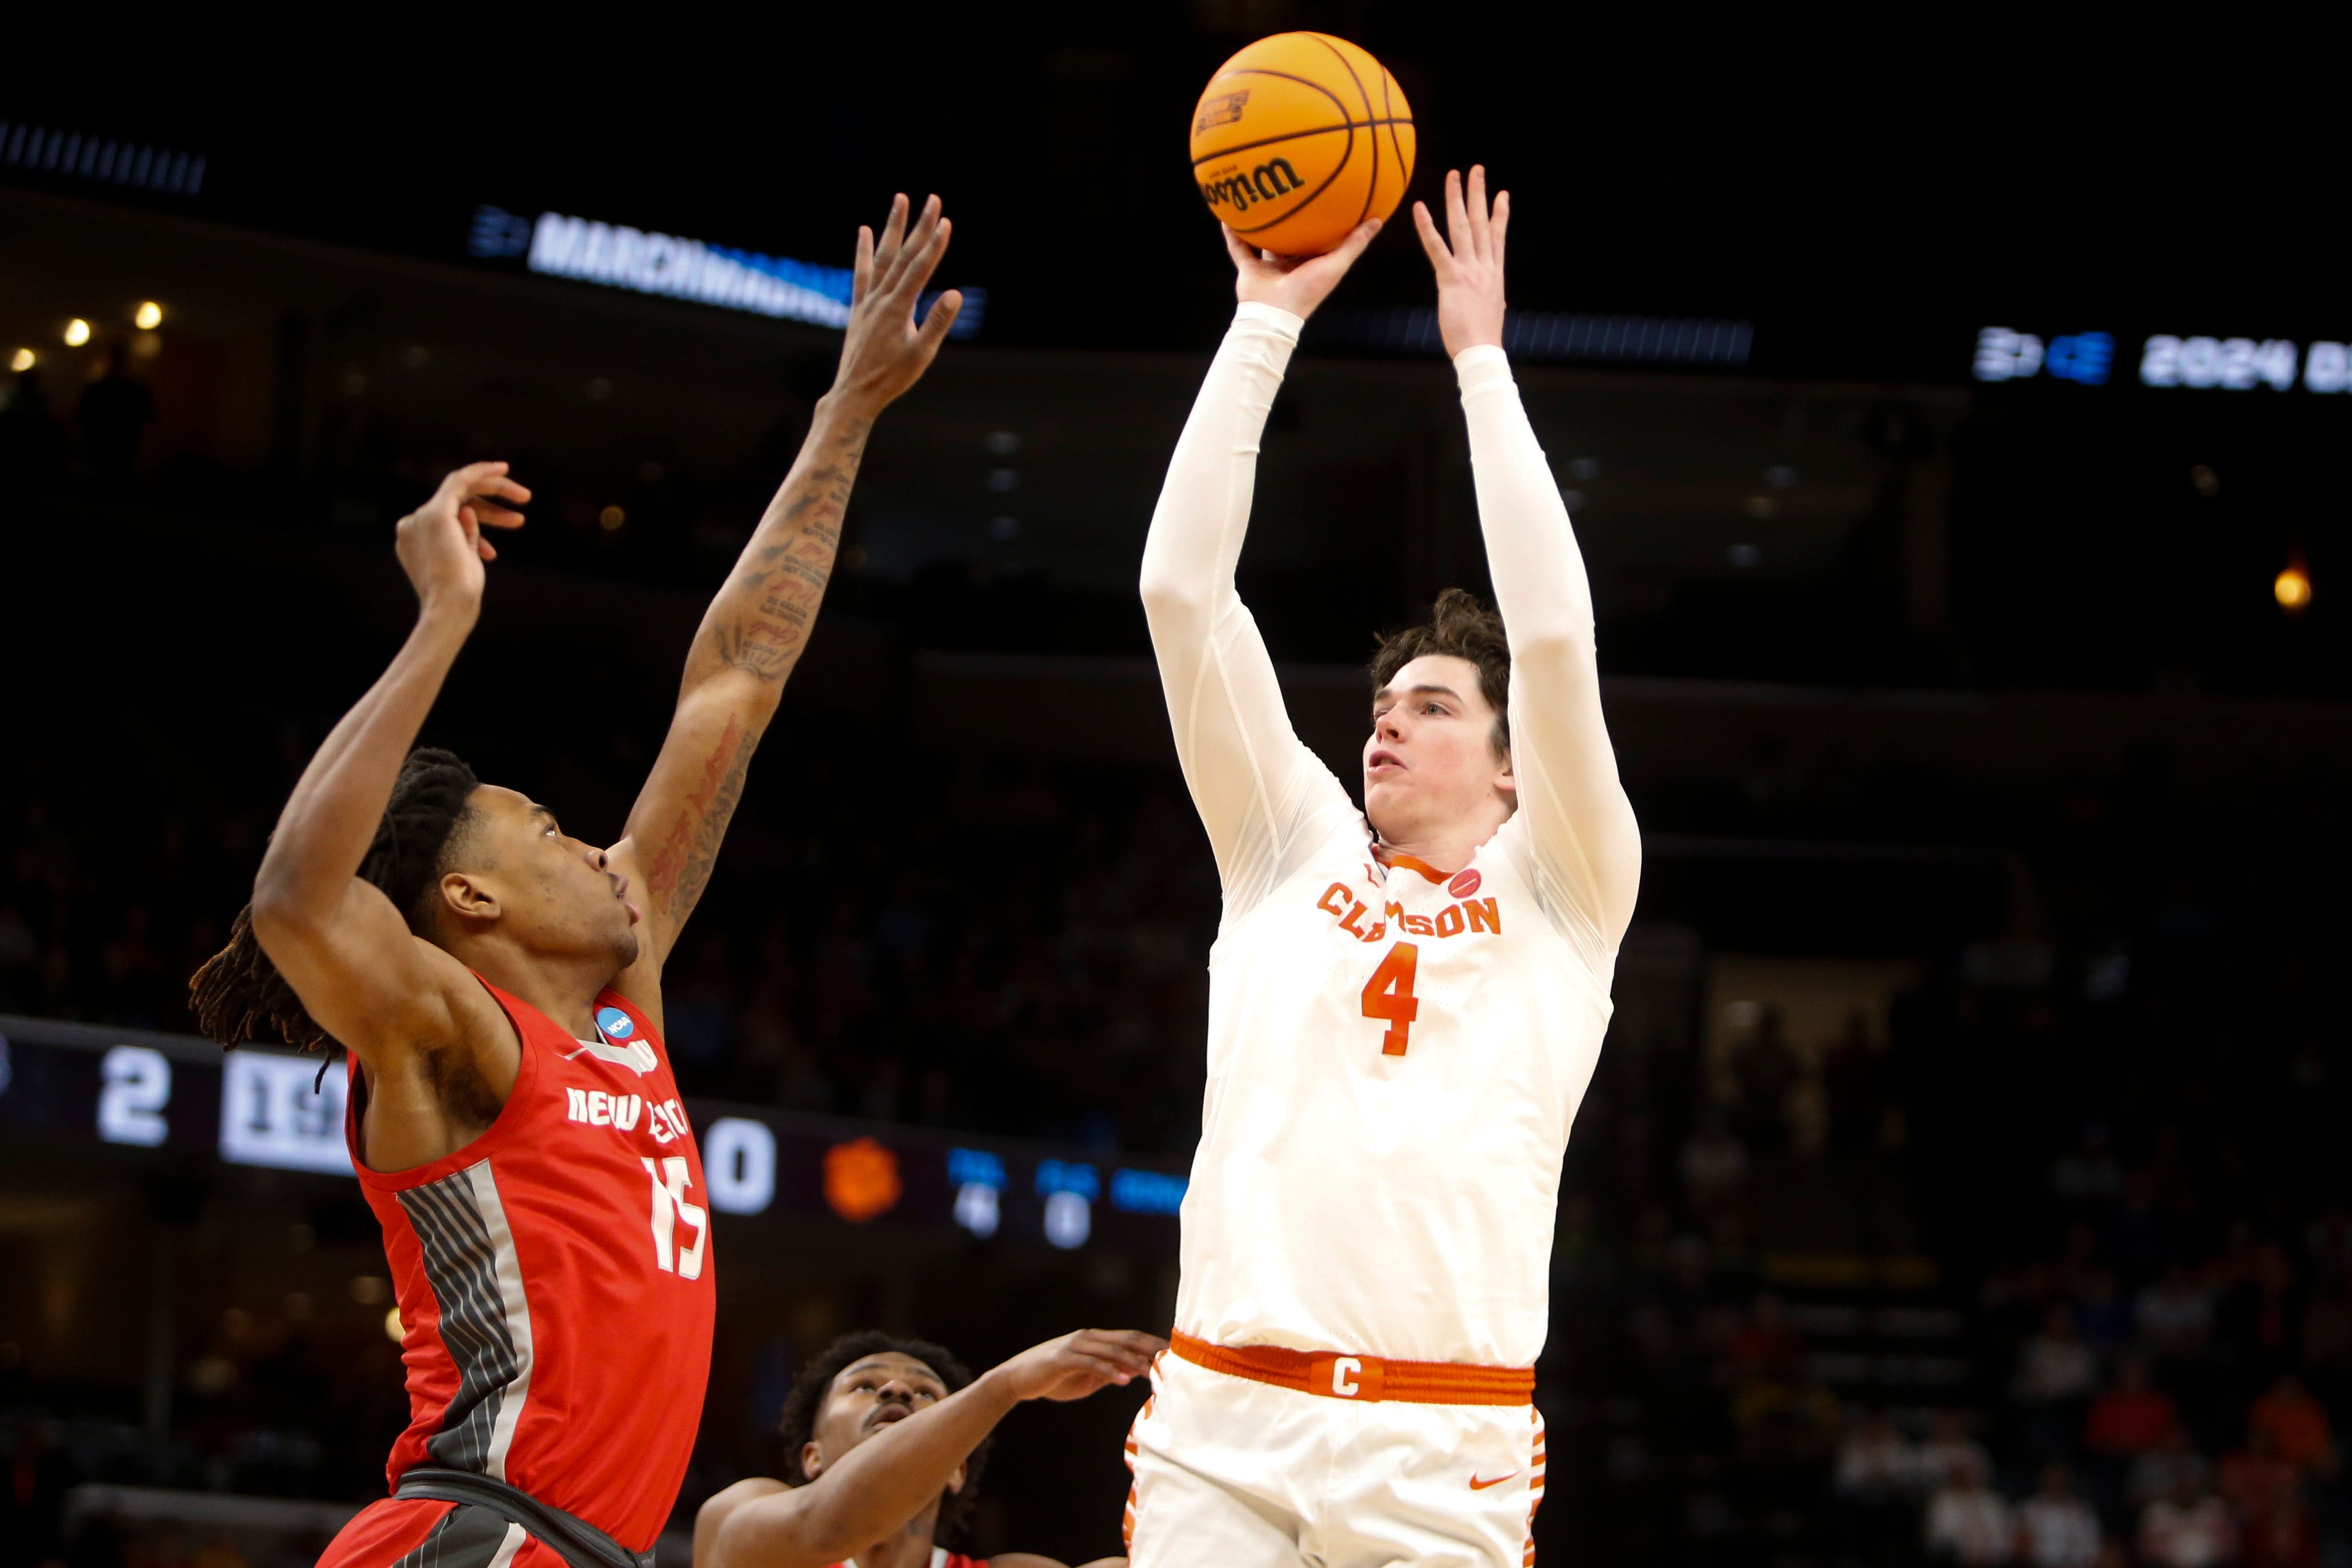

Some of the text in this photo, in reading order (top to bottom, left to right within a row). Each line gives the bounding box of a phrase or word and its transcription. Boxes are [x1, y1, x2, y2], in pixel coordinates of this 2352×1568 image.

[2139, 334, 2297, 392] 2024
[607, 1017, 631, 1034] NCAA
[1361, 941, 1418, 1056] 4
[98, 1044, 171, 1146] 2
[566, 1086, 642, 1131] NEW
[705, 1116, 777, 1216] 0
[641, 1156, 707, 1280] 15
[1332, 1357, 1361, 1396] C
